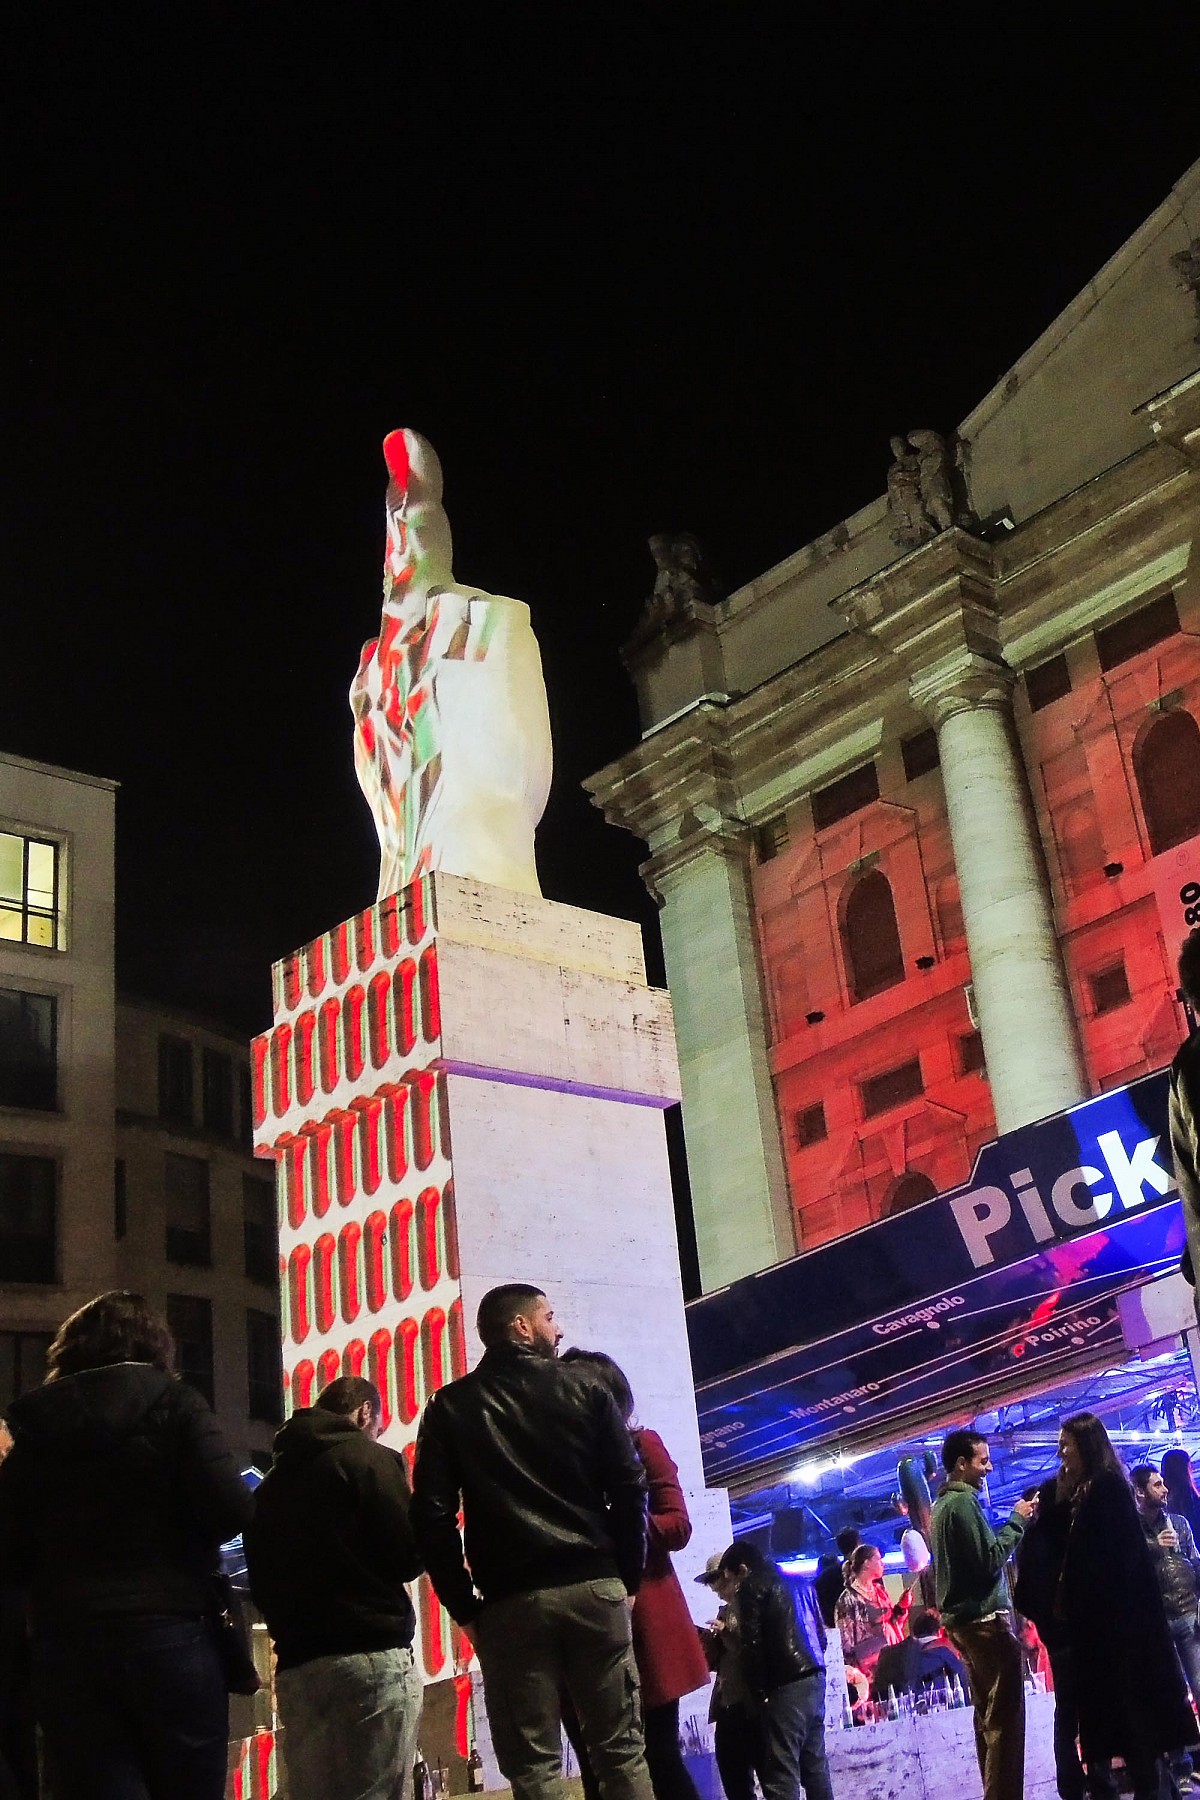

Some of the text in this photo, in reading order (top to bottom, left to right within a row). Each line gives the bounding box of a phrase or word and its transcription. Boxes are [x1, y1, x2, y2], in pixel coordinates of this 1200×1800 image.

[949, 1129, 1178, 1268] Pick
[872, 1295, 965, 1335] Cavagnolo
[1024, 1315, 1101, 1346] Poirino
[789, 1382, 880, 1419] Montanaro
